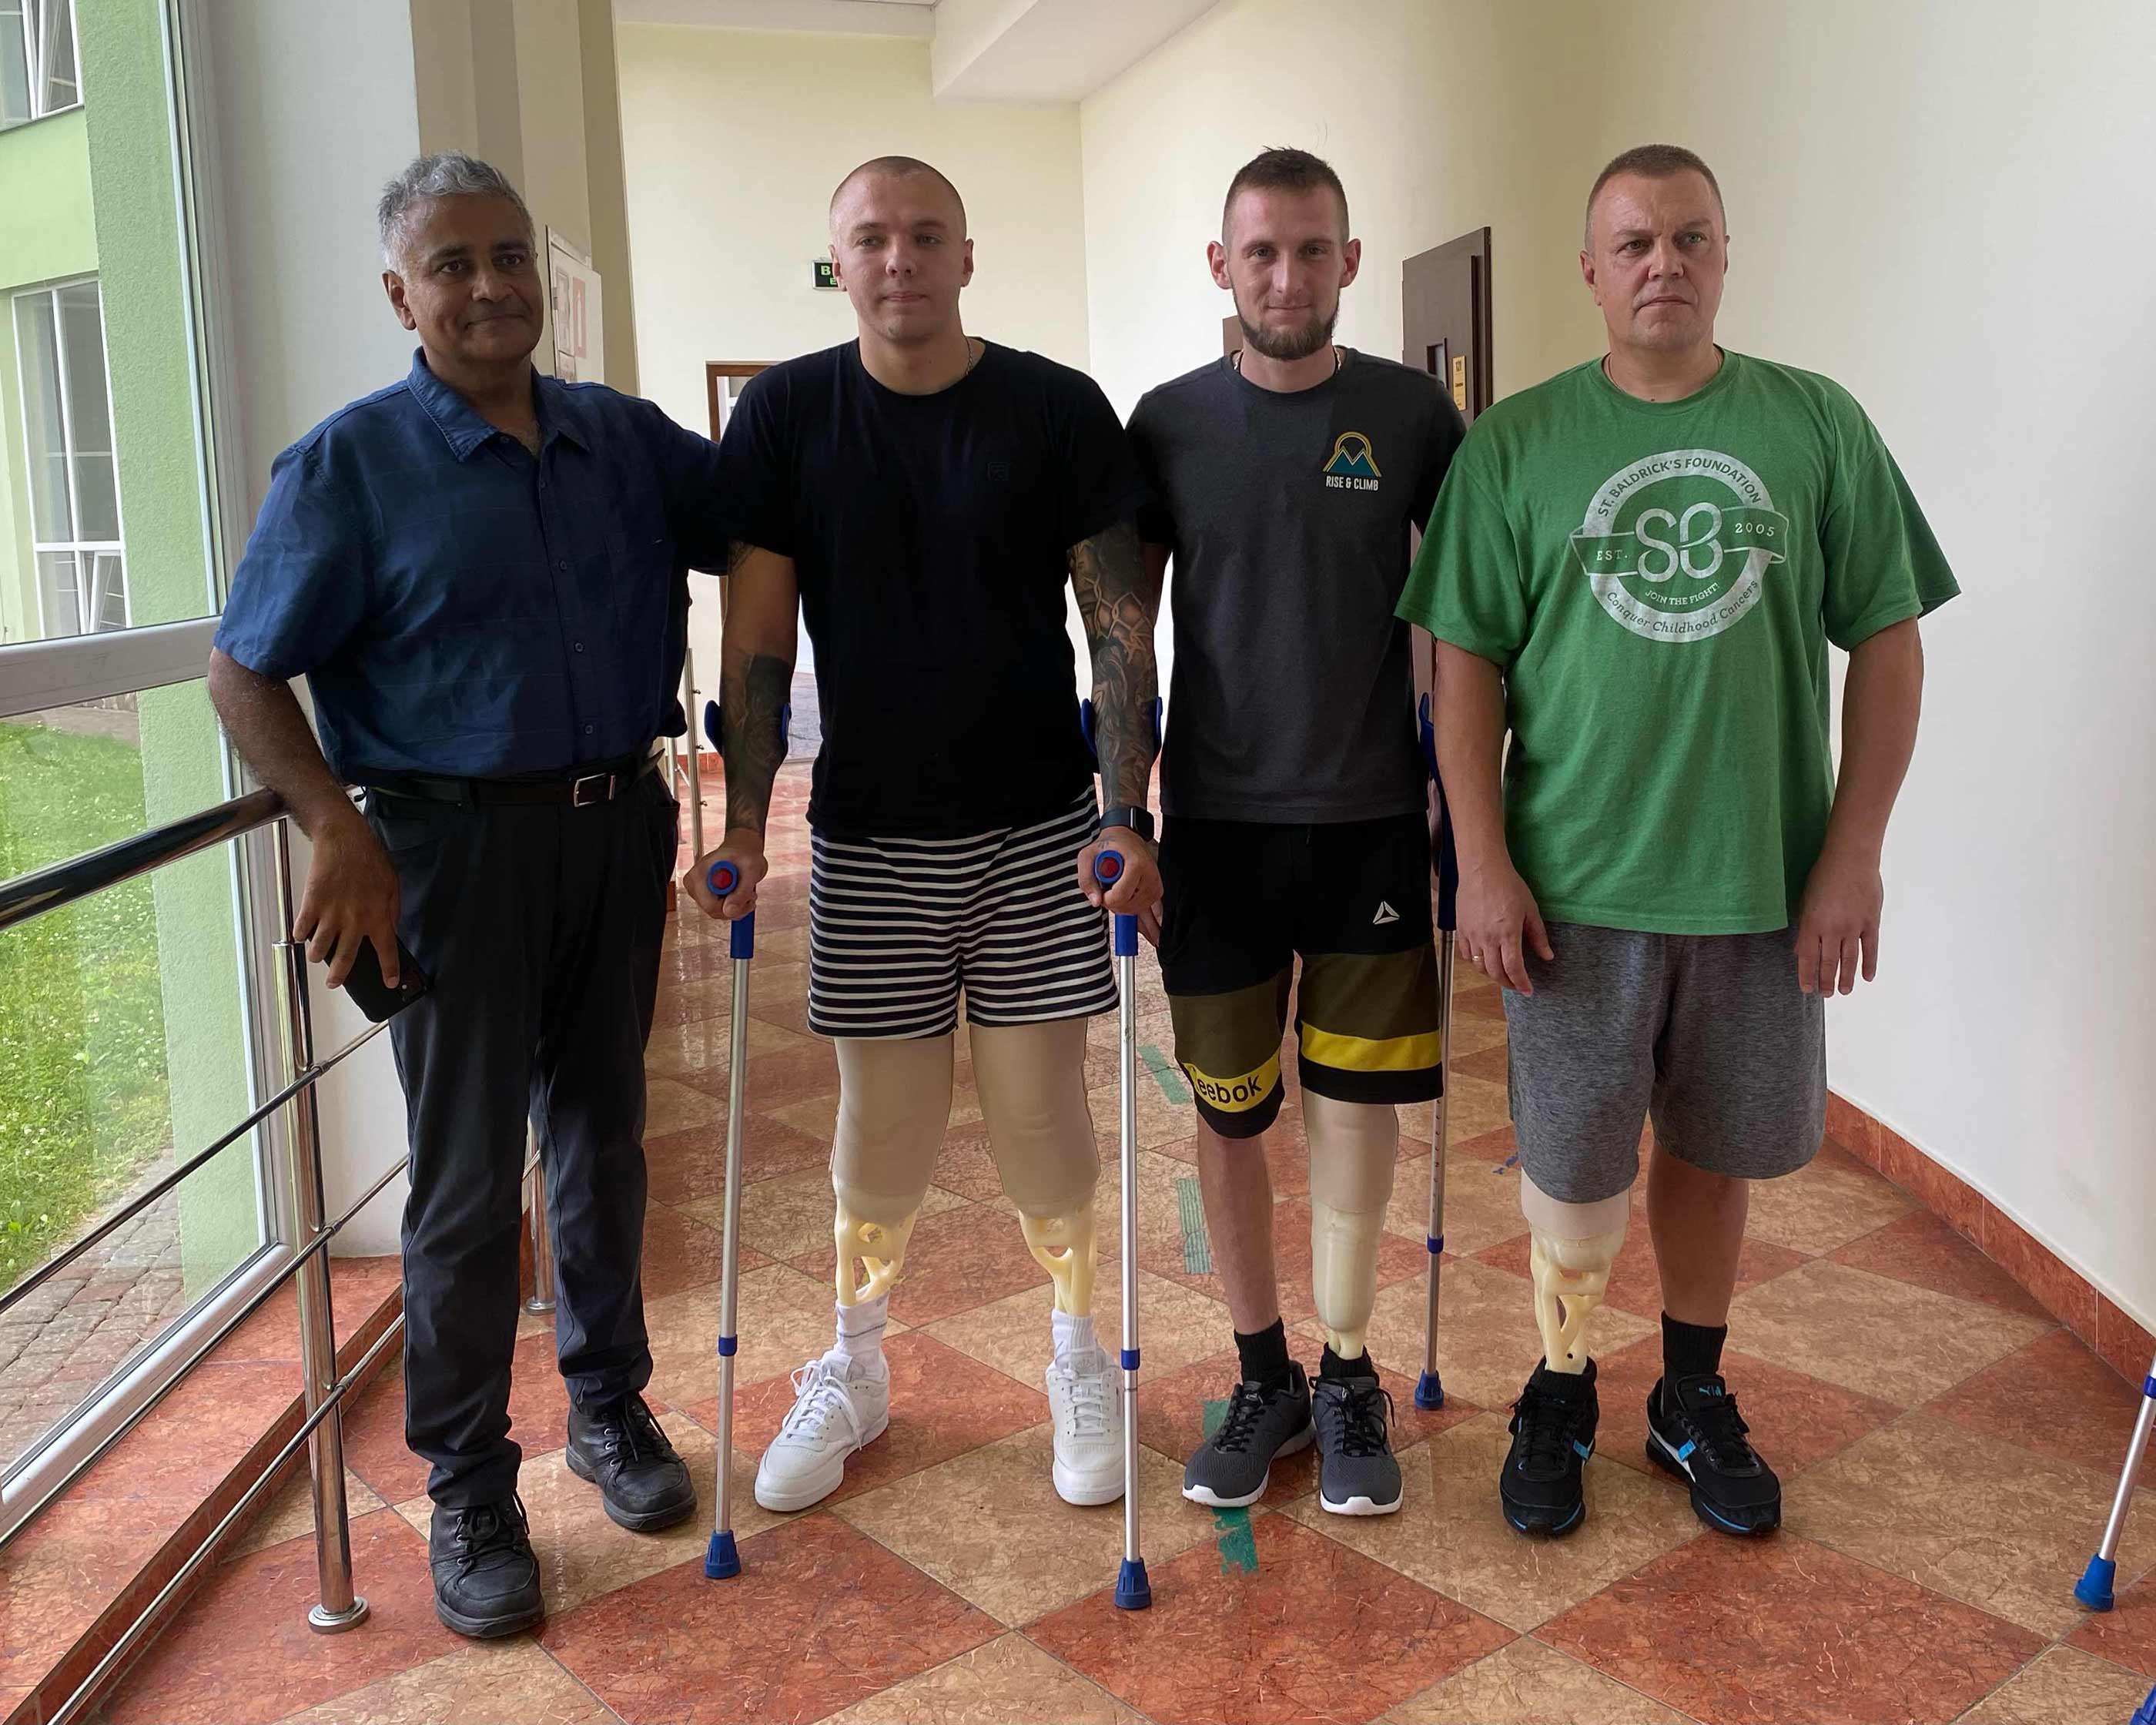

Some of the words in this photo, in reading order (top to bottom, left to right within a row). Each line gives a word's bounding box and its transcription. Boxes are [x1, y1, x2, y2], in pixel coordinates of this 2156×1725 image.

[1325, 475, 1344, 488] RISE
[1345, 477, 1352, 489] &
[1354, 477, 1379, 491] CLIMB
[1598, 498, 1615, 517] ST.
[1609, 459, 1682, 498] BALDRICK'S
[1685, 457, 1762, 504] FOUNDATION
[1596, 549, 1629, 561] EST.
[1735, 522, 1775, 537] 2005
[1607, 591, 1651, 627] Conquer
[1652, 613, 1719, 634] Childhood
[1719, 580, 1758, 619] Cancers
[1645, 589, 1667, 605] JOIN
[1668, 596, 1689, 605] THE
[1689, 581, 1720, 605] FIGHT!
[1196, 1075, 1263, 1104] eebok
